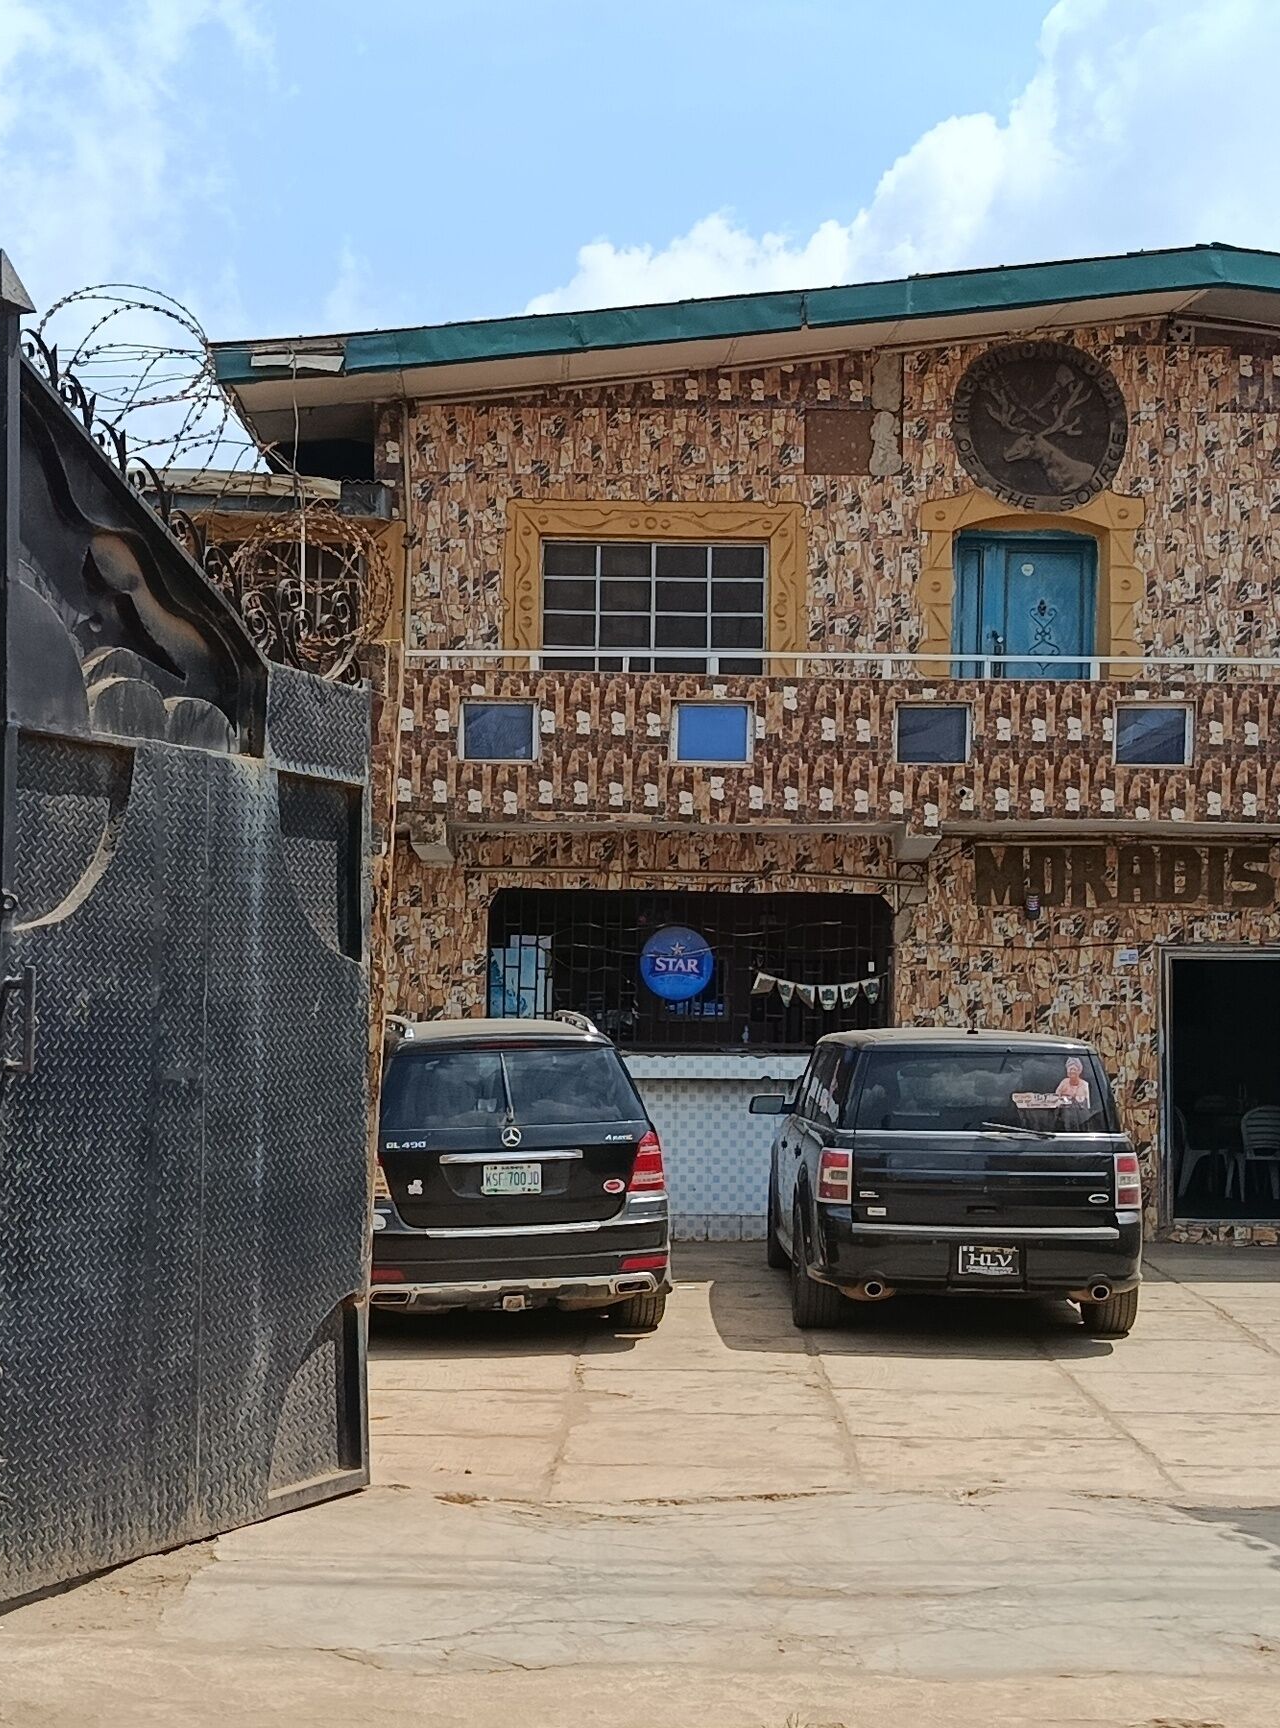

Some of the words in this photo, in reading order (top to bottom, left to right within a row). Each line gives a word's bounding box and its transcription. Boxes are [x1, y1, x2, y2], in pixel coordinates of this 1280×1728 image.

[958, 438, 980, 465] OF
[994, 483, 1037, 509] THE
[1059, 432, 1126, 512] SOURCE
[974, 844, 1276, 909] MORADIS
[654, 957, 700, 974] STAR
[967, 1253, 1013, 1267] HLV
